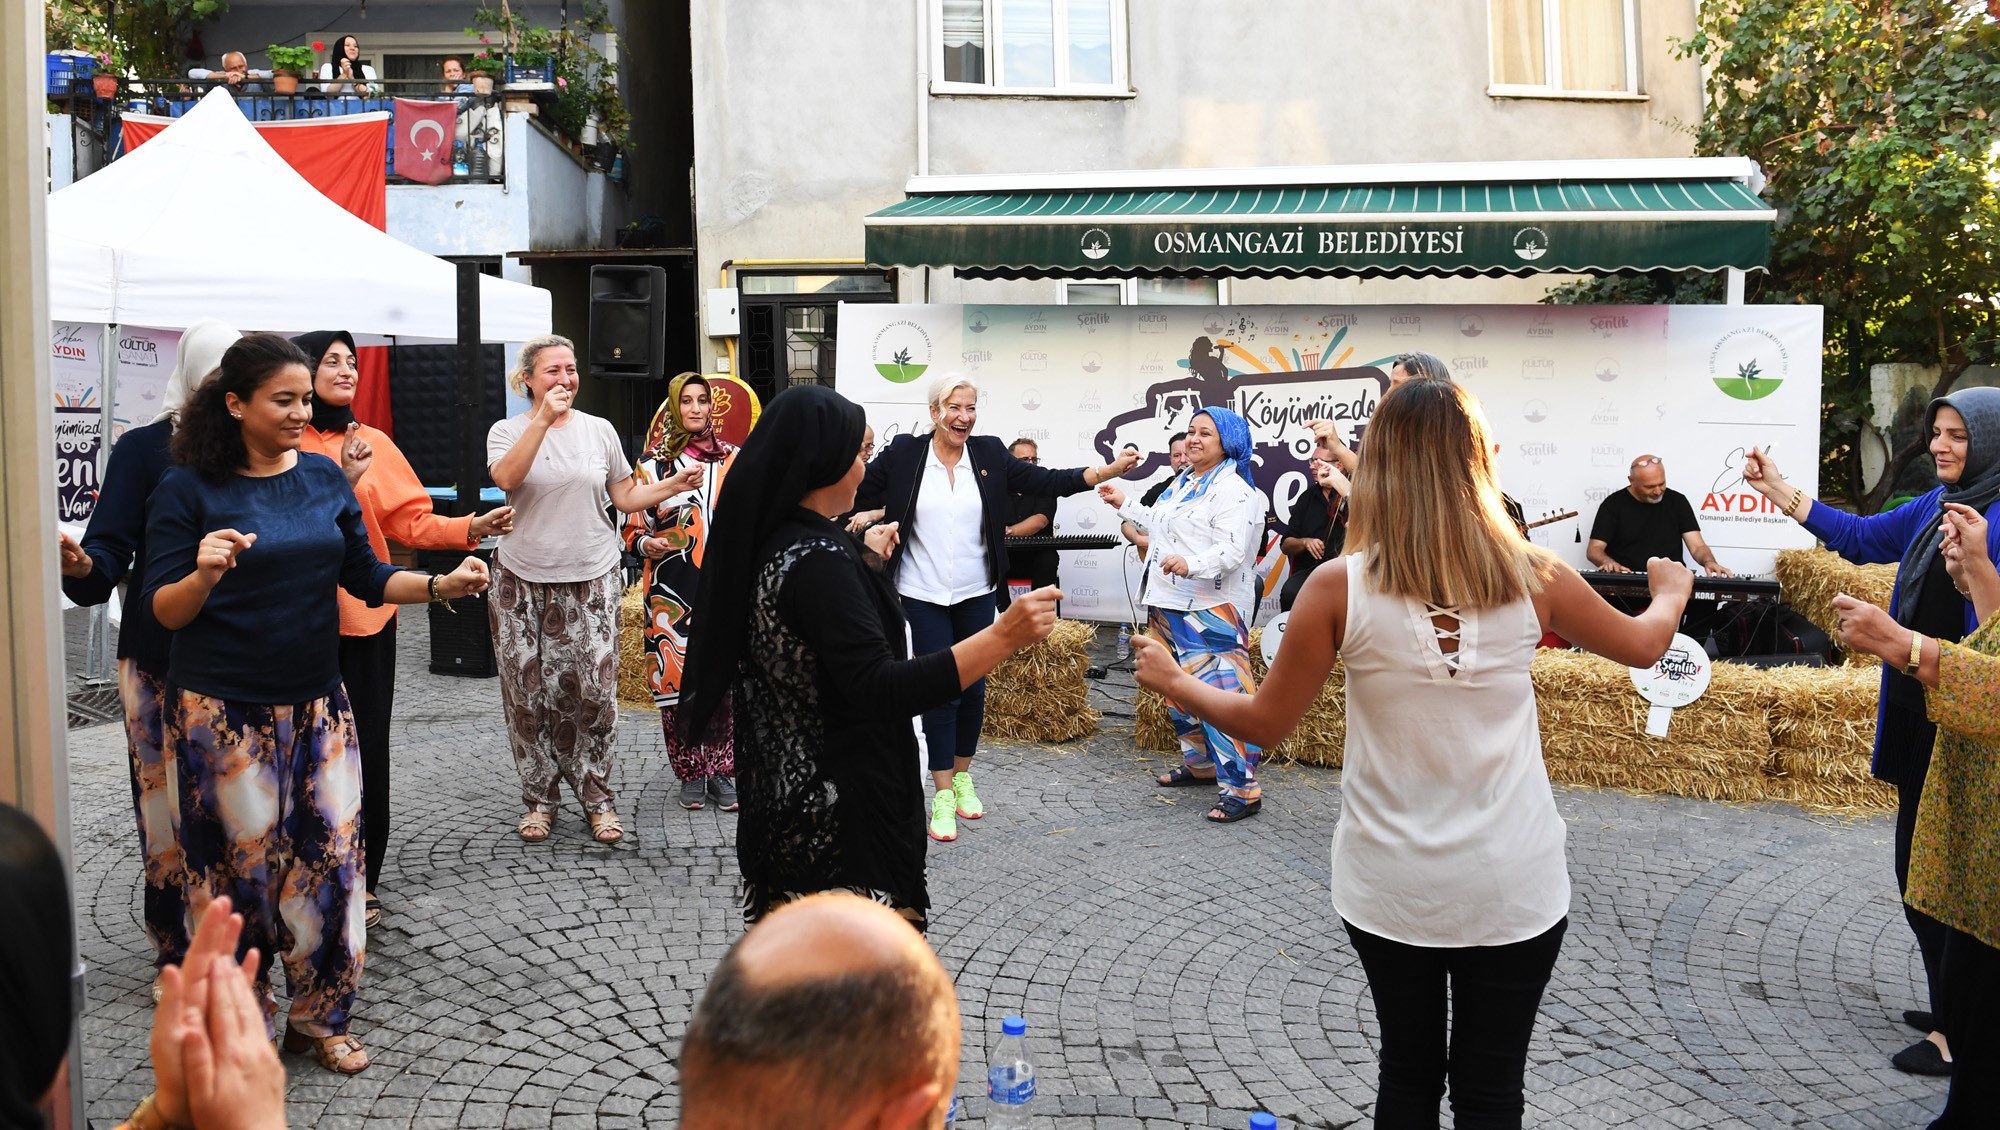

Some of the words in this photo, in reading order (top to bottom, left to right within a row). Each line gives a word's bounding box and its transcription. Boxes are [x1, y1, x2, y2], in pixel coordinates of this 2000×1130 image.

[1154, 226, 1303, 254] OSMANGAZİ
[1318, 225, 1463, 254] BELEDİYESİ
[53, 345, 85, 357] YDIN
[1242, 389, 1375, 439] Köyümüzde
[55, 420, 101, 441] yümüzd
[62, 485, 91, 518] Var
[1700, 514, 1733, 523] Osmangazi
[1735, 515, 1761, 524] Belediye
[1763, 516, 1787, 524] Başkanı
[1695, 592, 1715, 600] KORG
[1661, 659, 1696, 675] Şenlik
